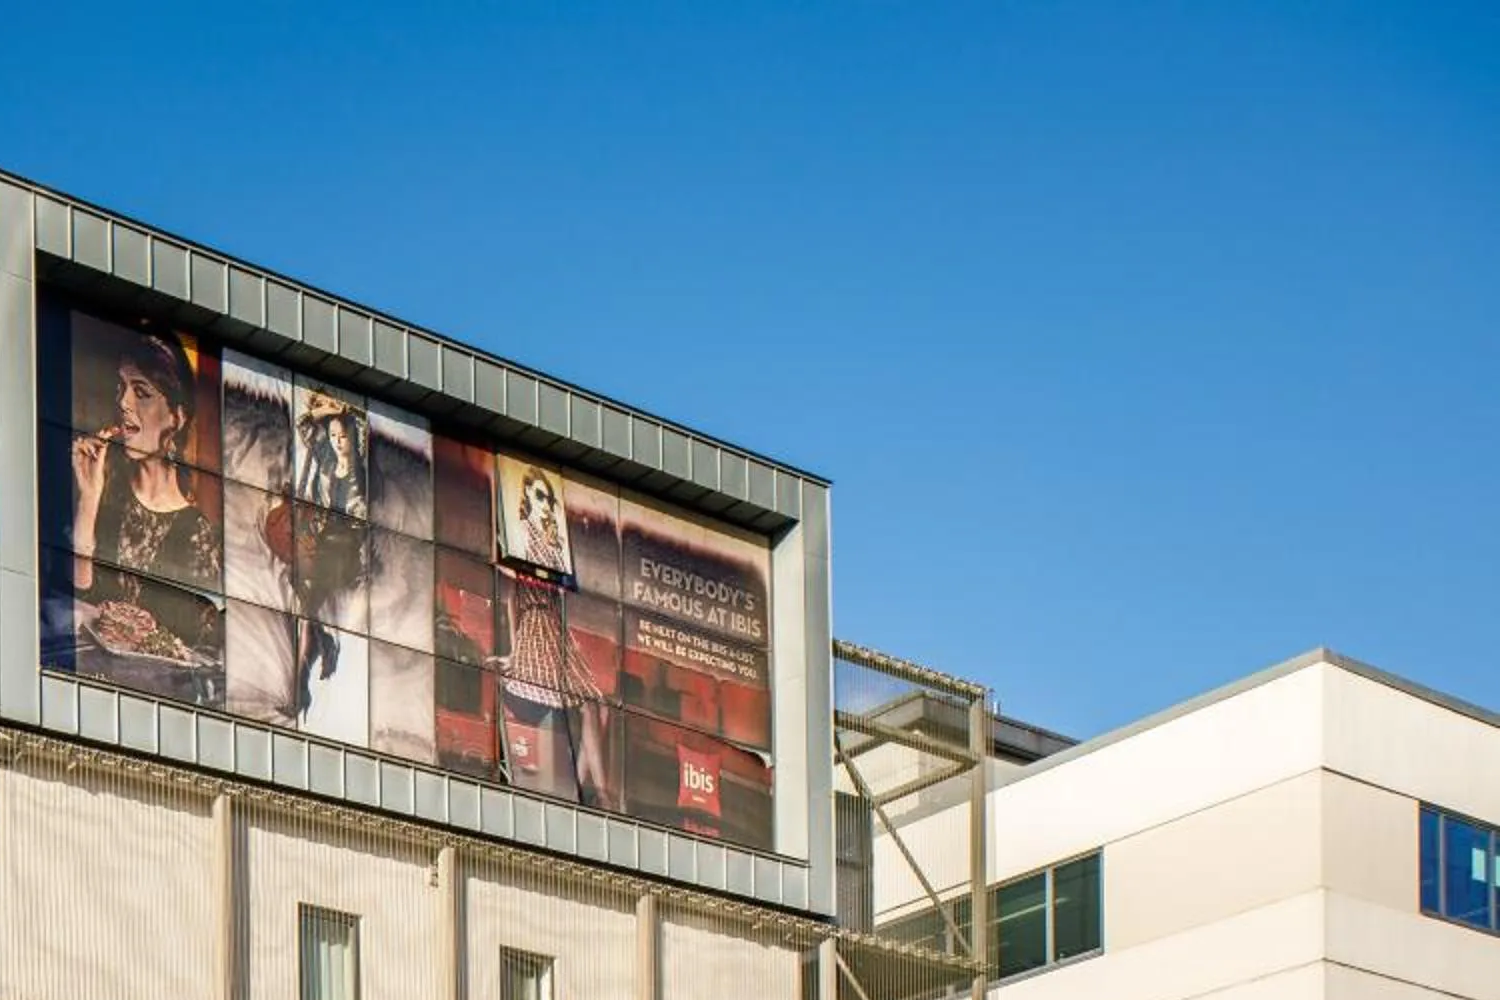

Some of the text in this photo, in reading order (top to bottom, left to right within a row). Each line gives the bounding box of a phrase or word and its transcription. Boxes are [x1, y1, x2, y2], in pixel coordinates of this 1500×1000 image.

[640, 557, 755, 611] EVERYBODY'S
[633, 581, 761, 638] FAMOUS AT IBIS
[637, 633, 652, 646] WE
[653, 639, 674, 653] WILL
[675, 645, 688, 657] BE
[687, 648, 737, 673] EXPECTING
[677, 631, 691, 643] ON
[691, 635, 711, 651] THE
[683, 761, 714, 794] ibis
